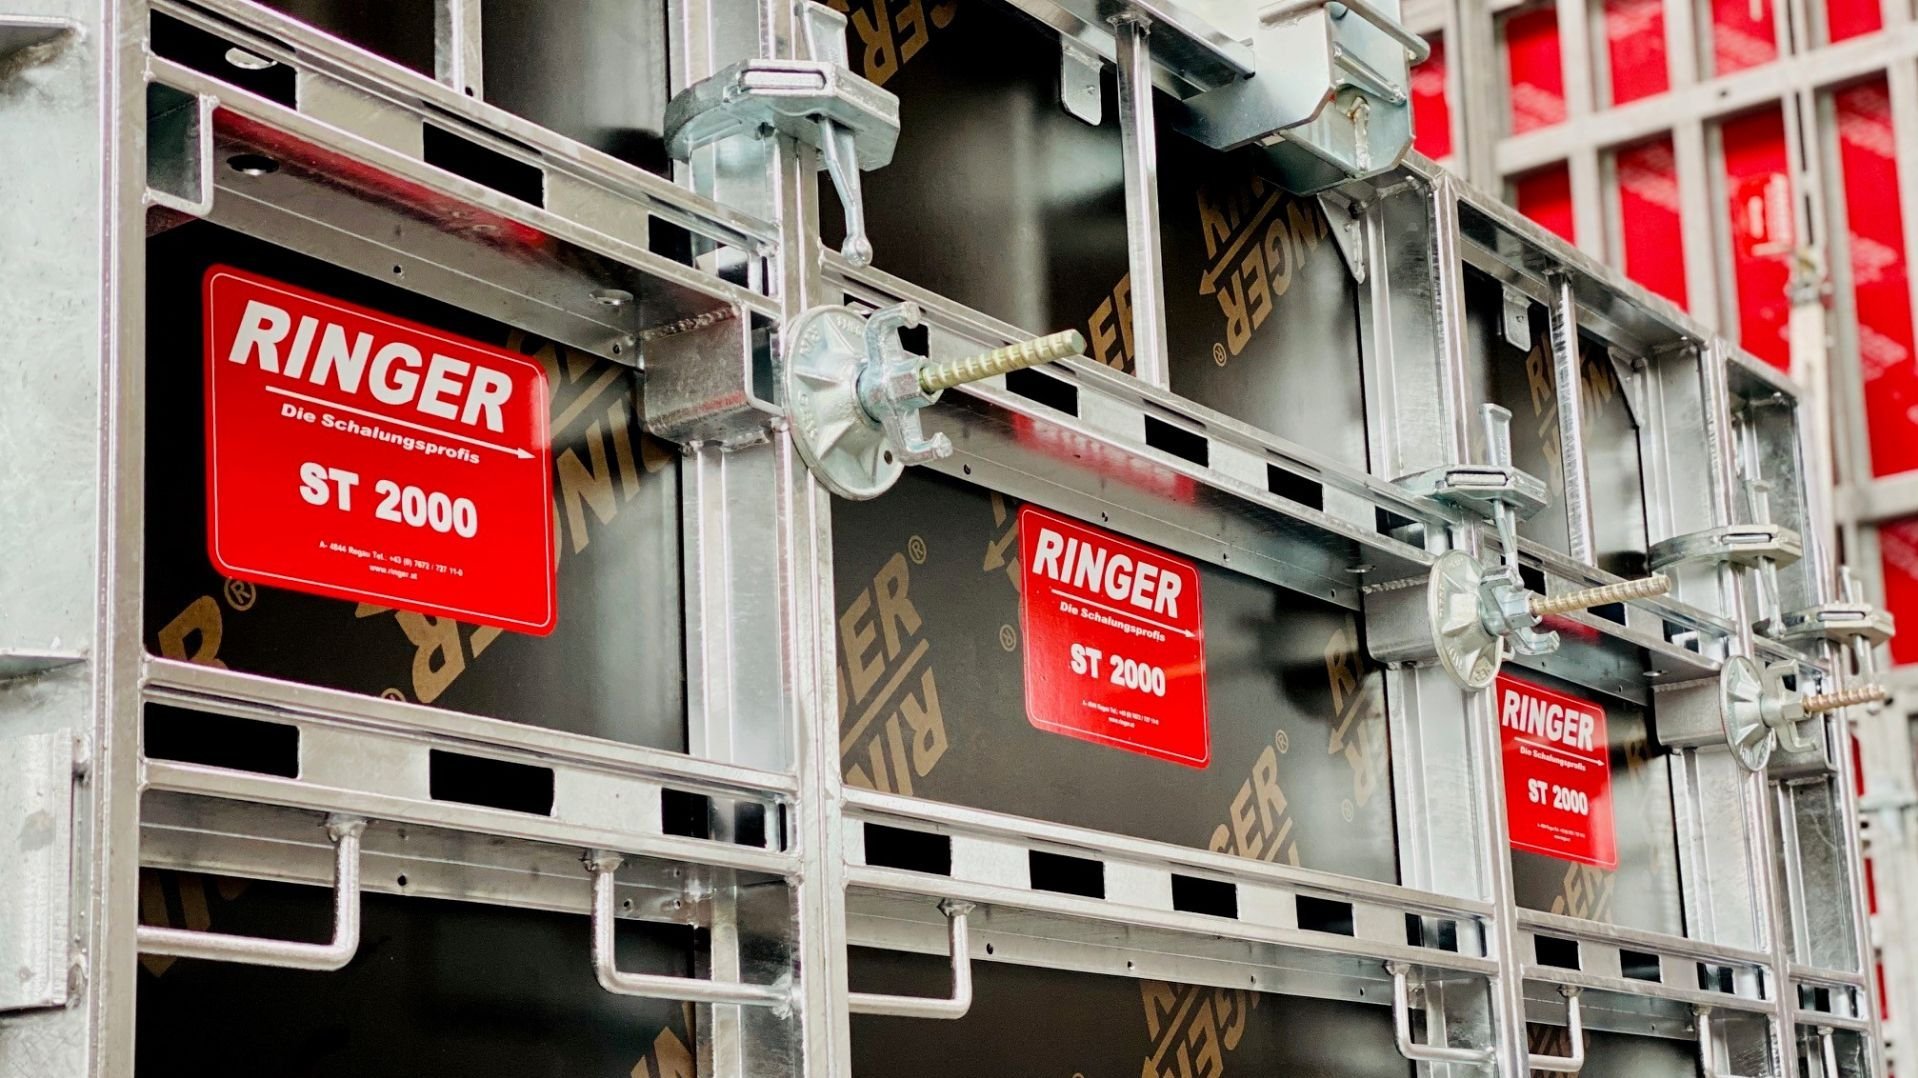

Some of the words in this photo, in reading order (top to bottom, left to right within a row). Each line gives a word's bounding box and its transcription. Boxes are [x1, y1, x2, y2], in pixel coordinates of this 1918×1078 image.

[228, 300, 513, 433] RINGER
[280, 403, 315, 424] Die
[321, 414, 480, 465] Schalungsprofis
[299, 462, 359, 511] ST
[375, 479, 478, 539] 2000
[1032, 527, 1182, 619] RINGER
[1059, 600, 1079, 616] Die
[1080, 608, 1166, 642] Schalungsprofis
[1070, 643, 1102, 679] ST
[1110, 655, 1166, 697] 2000
[1502, 689, 1595, 752] RINGER
[1519, 746, 1532, 757] Die
[1532, 750, 1586, 772] Schalungsprofis
[1527, 778, 1548, 805] ST
[1552, 784, 1589, 816] 2000
